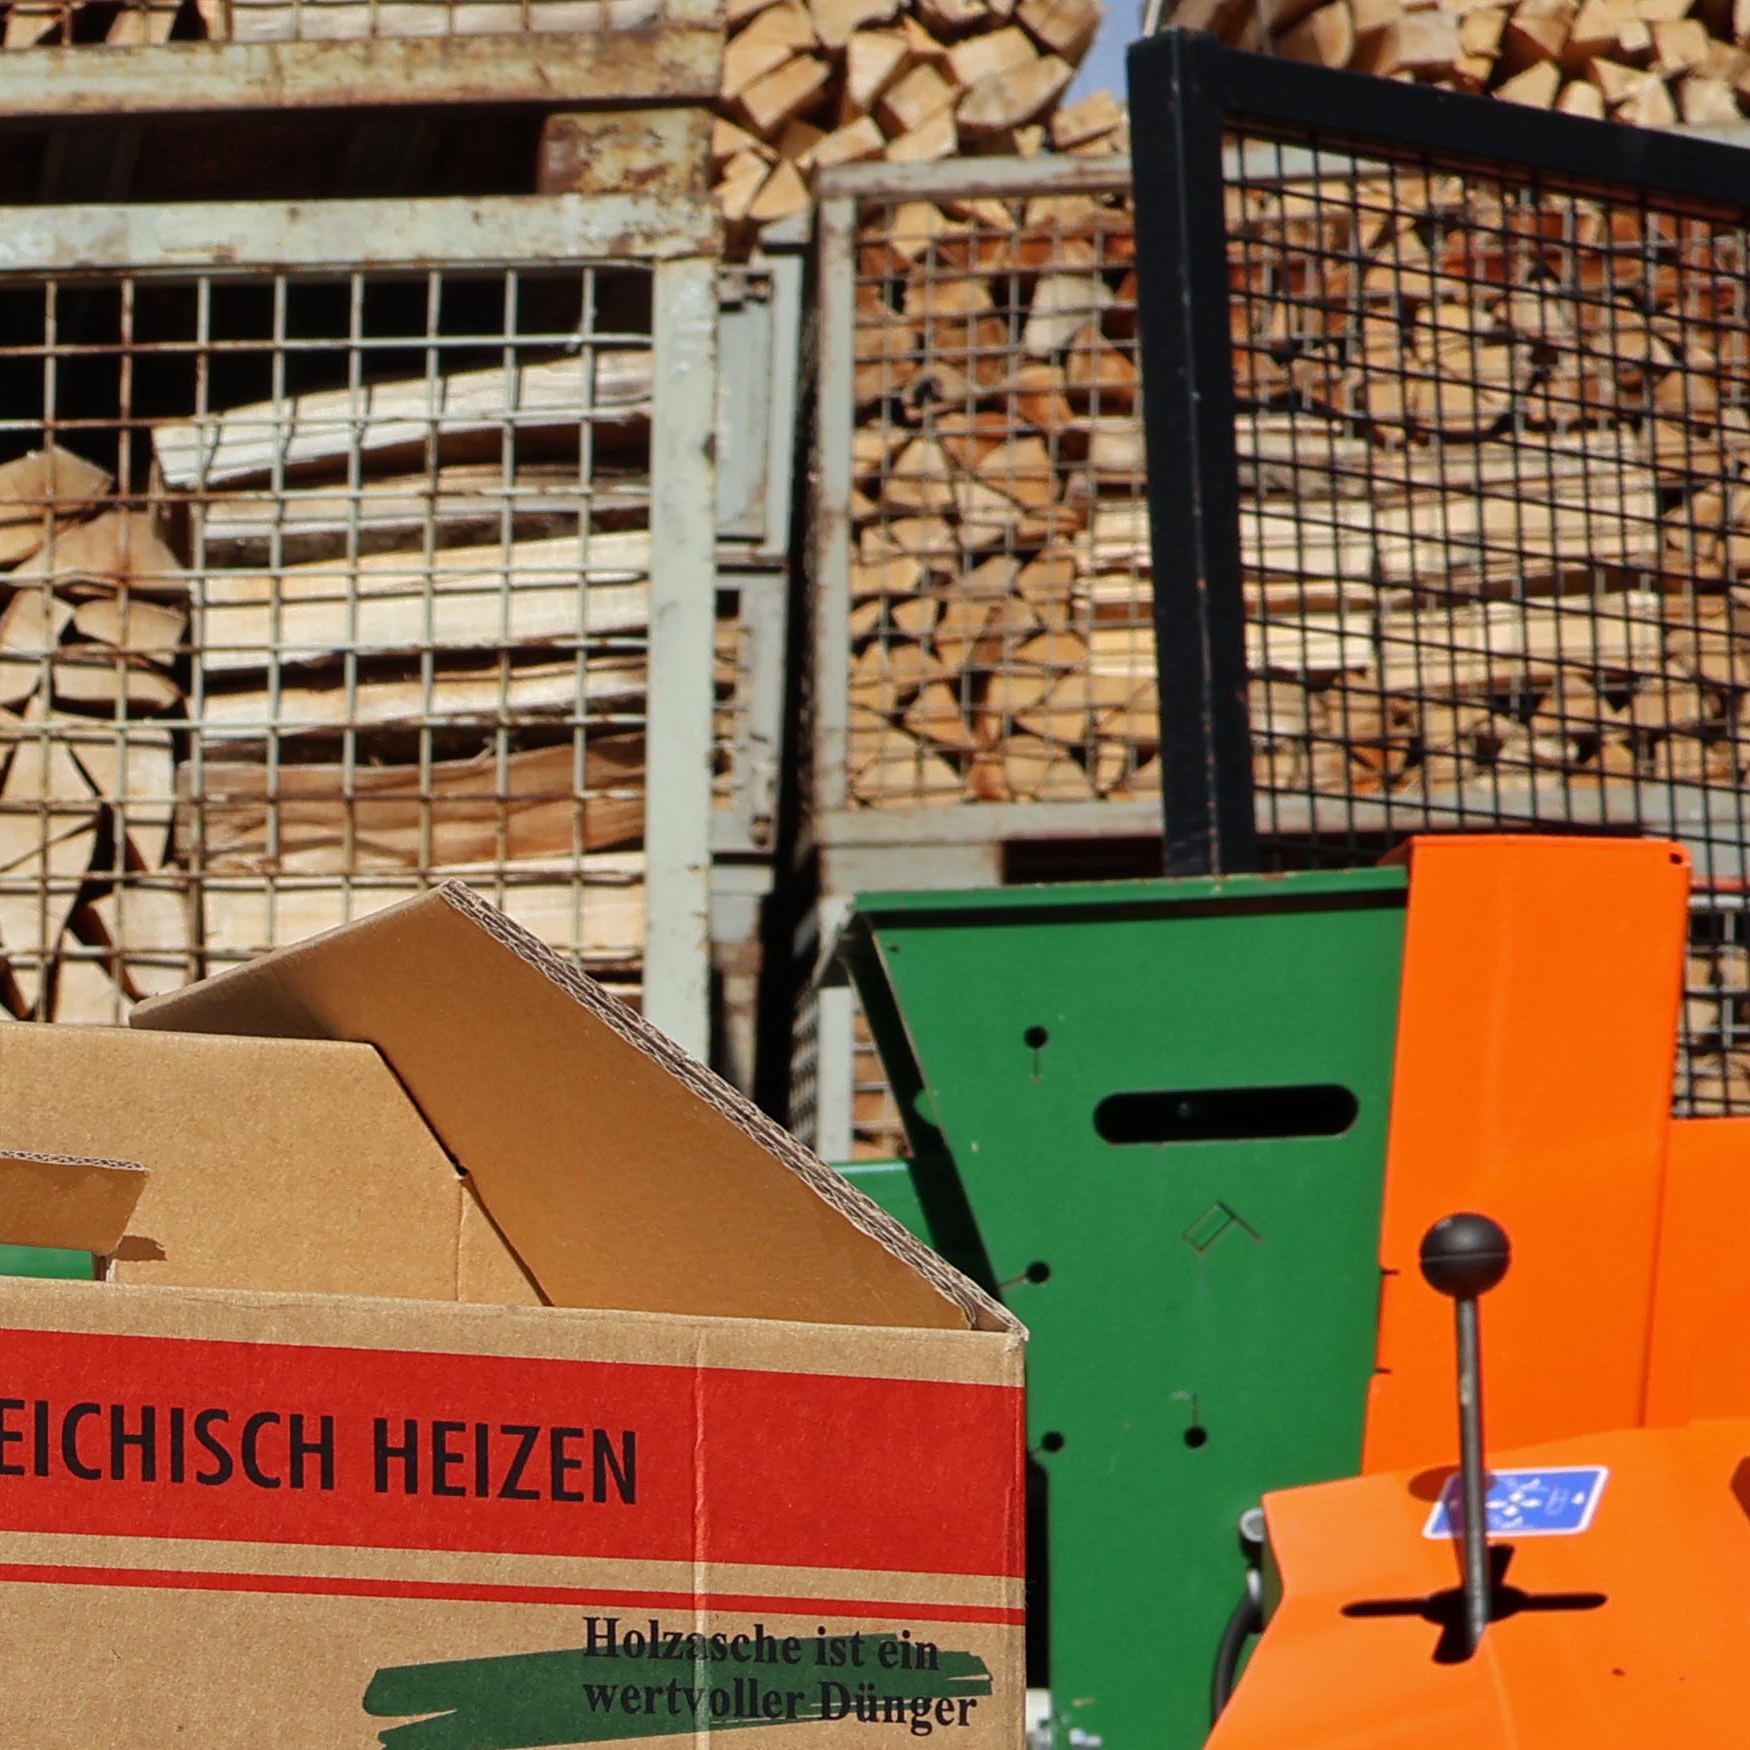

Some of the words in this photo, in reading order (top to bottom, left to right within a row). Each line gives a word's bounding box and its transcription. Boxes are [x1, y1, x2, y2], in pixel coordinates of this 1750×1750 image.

[374, 1418, 638, 1505] HEIZEN
[582, 1616, 802, 1667] Holzasche
[814, 1626, 866, 1668] ist
[877, 1630, 939, 1672] ein
[582, 1678, 805, 1722] wertvoller
[818, 1682, 977, 1737] Dünger
